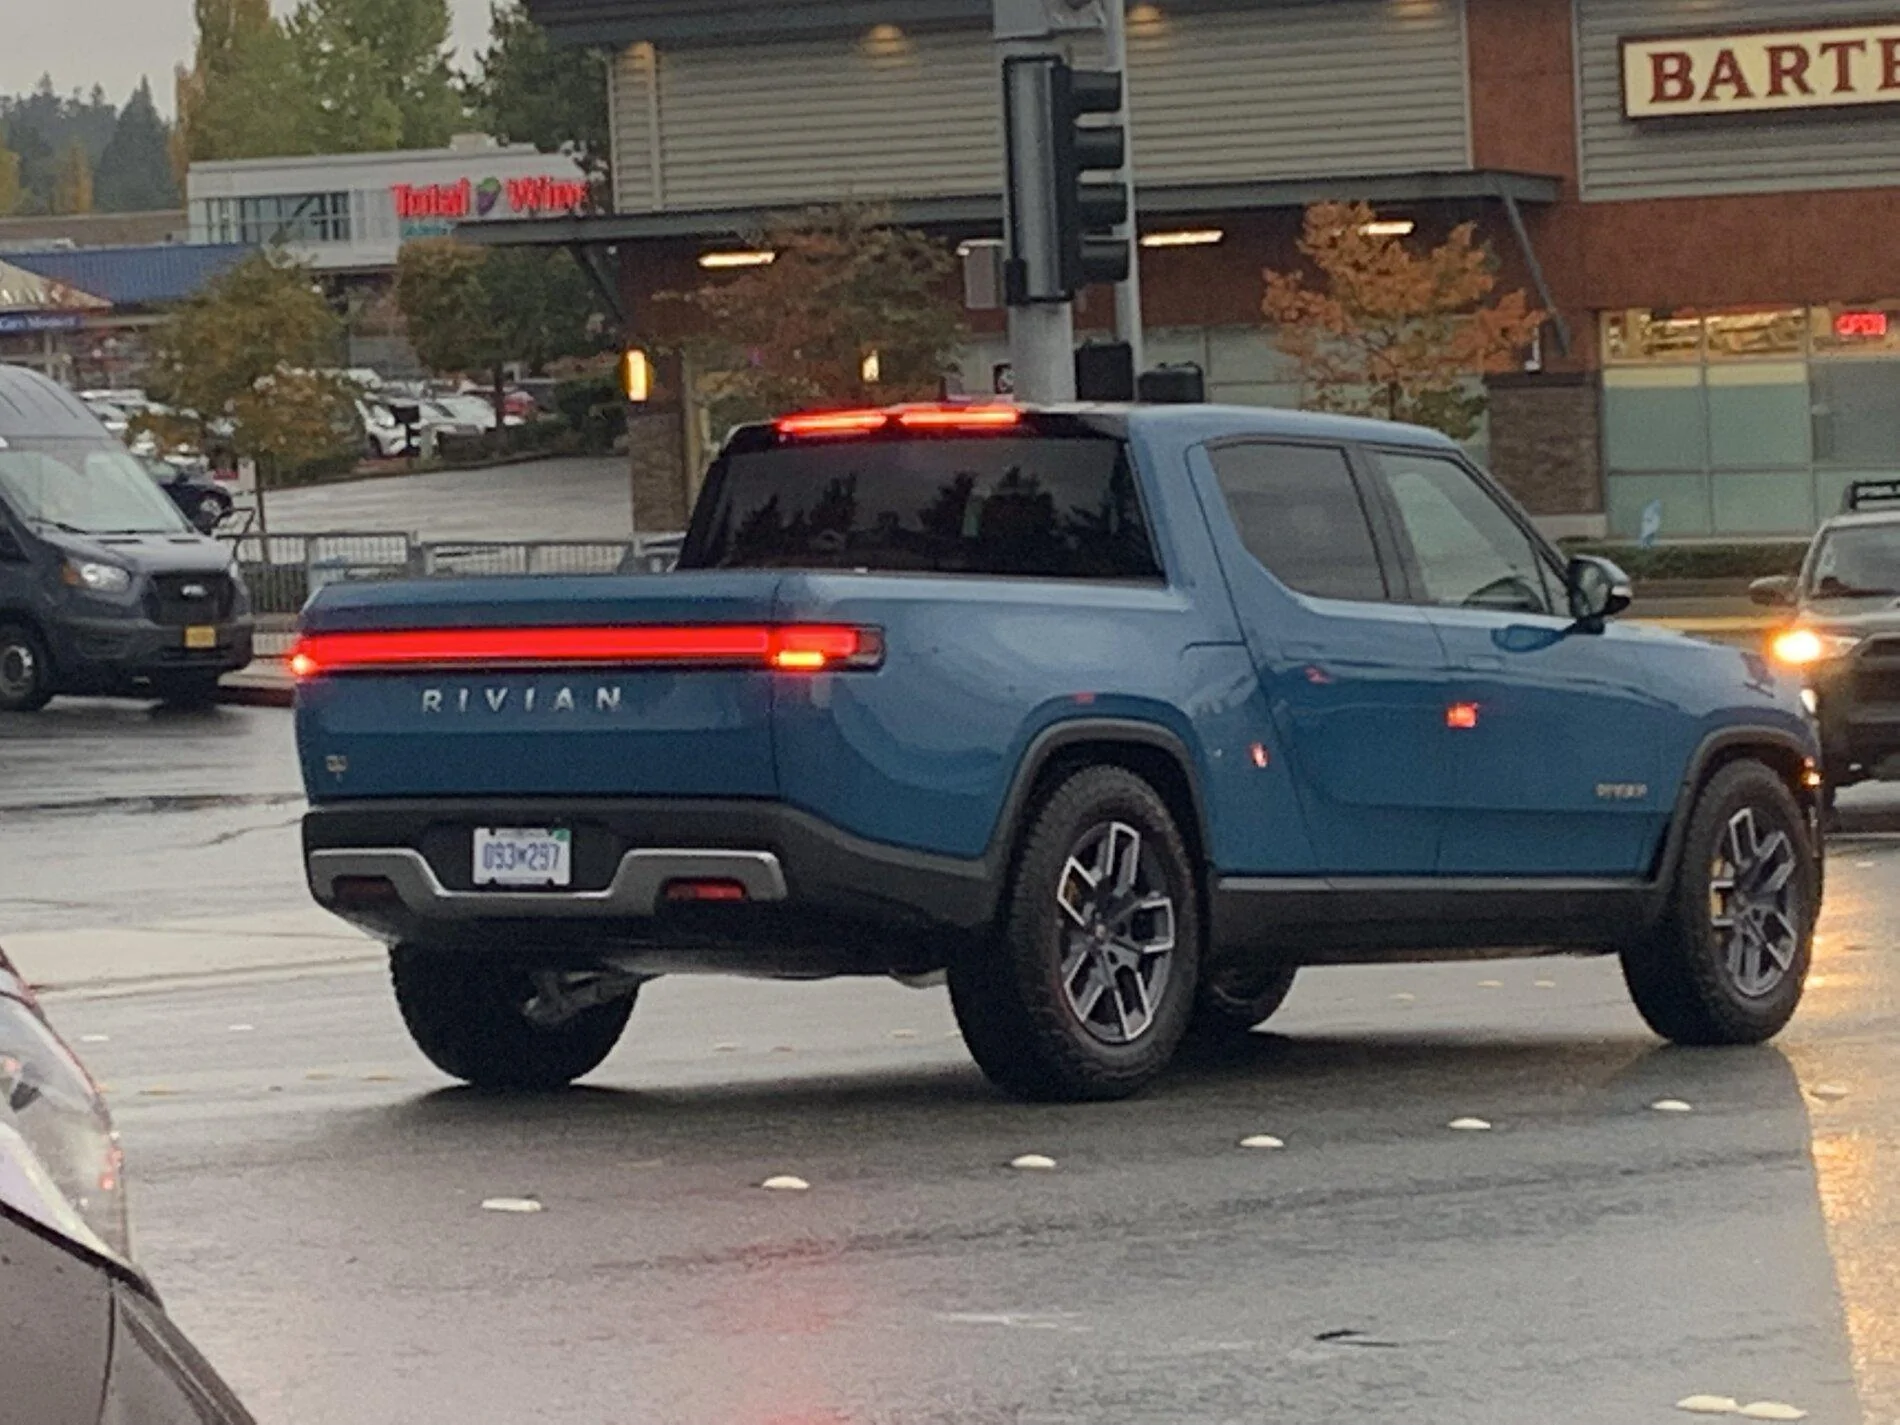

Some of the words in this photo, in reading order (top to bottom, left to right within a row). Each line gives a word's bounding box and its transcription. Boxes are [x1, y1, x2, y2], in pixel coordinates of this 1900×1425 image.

[391, 177, 471, 218] Total
[1835, 312, 1887, 336] OPEN
[422, 686, 622, 713] RIVIAN
